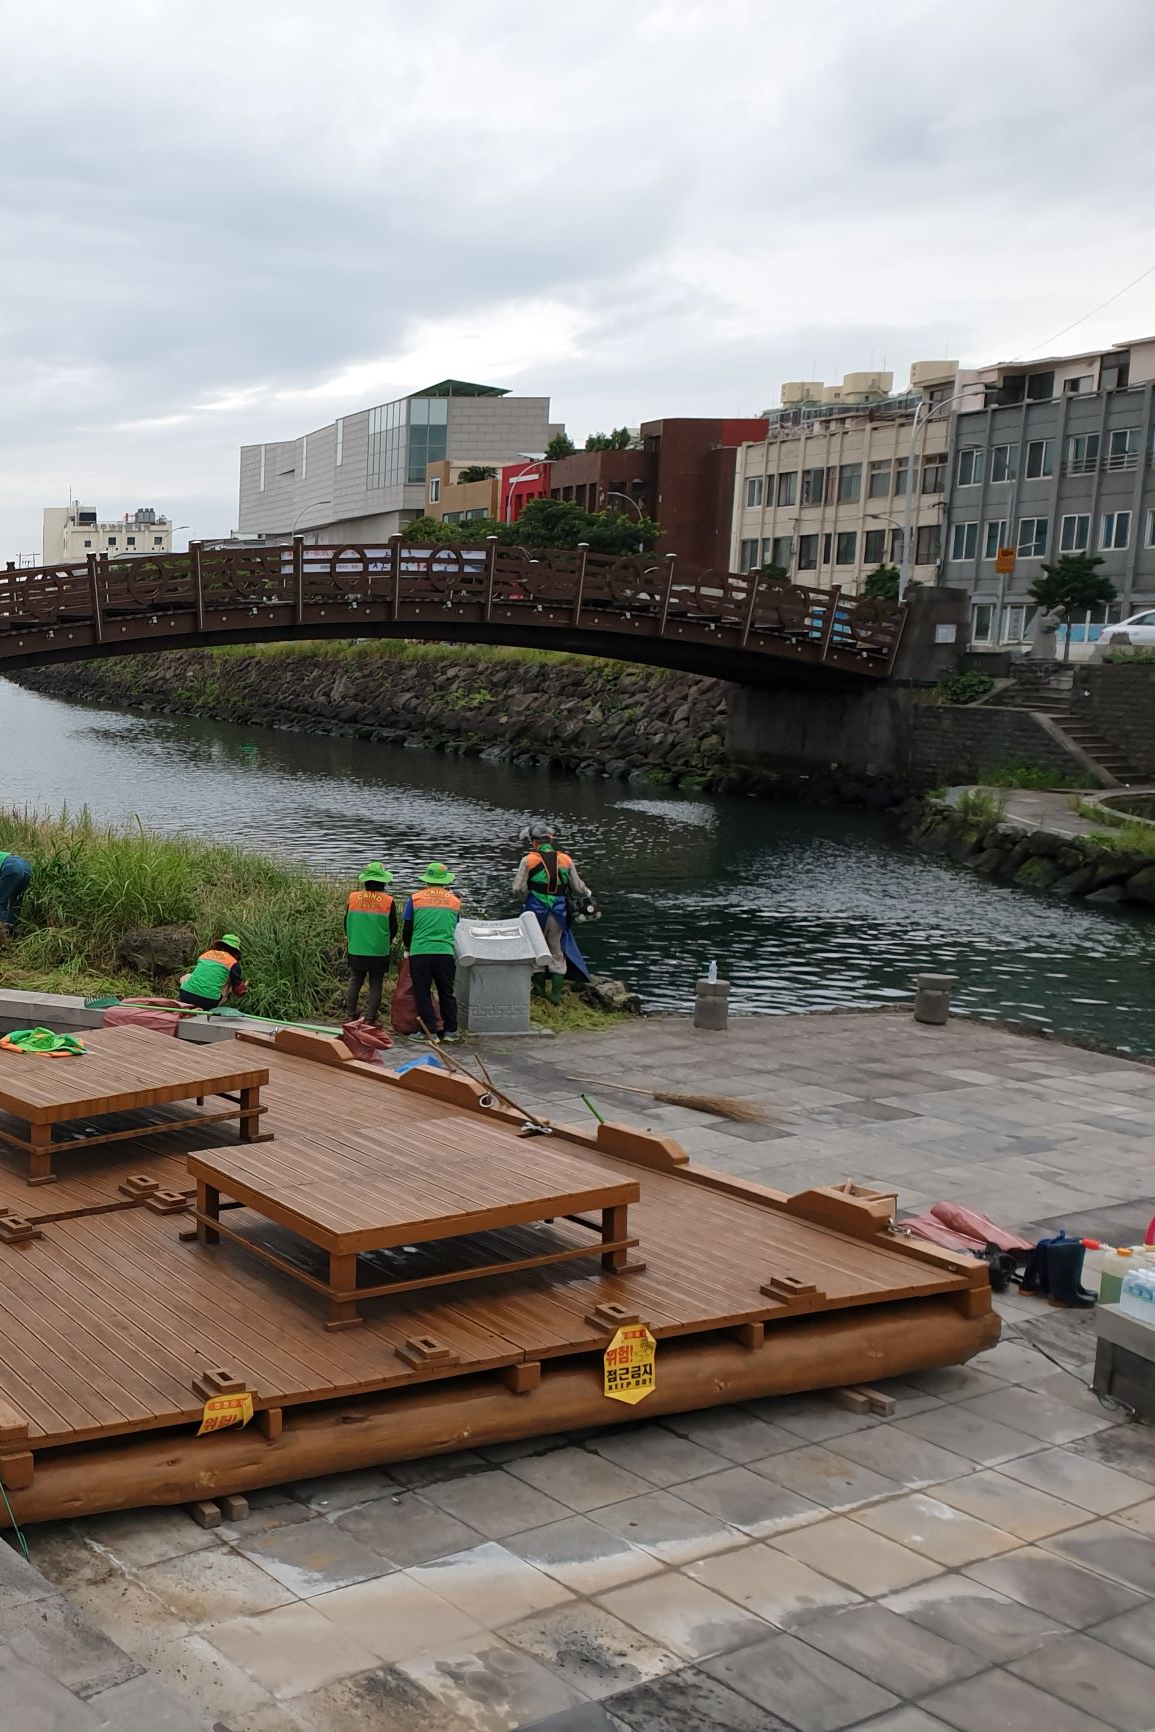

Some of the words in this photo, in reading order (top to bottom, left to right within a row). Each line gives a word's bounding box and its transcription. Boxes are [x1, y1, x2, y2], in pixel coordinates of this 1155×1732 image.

[605, 1345, 634, 1366] 위험!
[606, 1362, 653, 1383] 접근금지
[608, 1381, 632, 1391] KEEP
[635, 1377, 653, 1387] OUT
